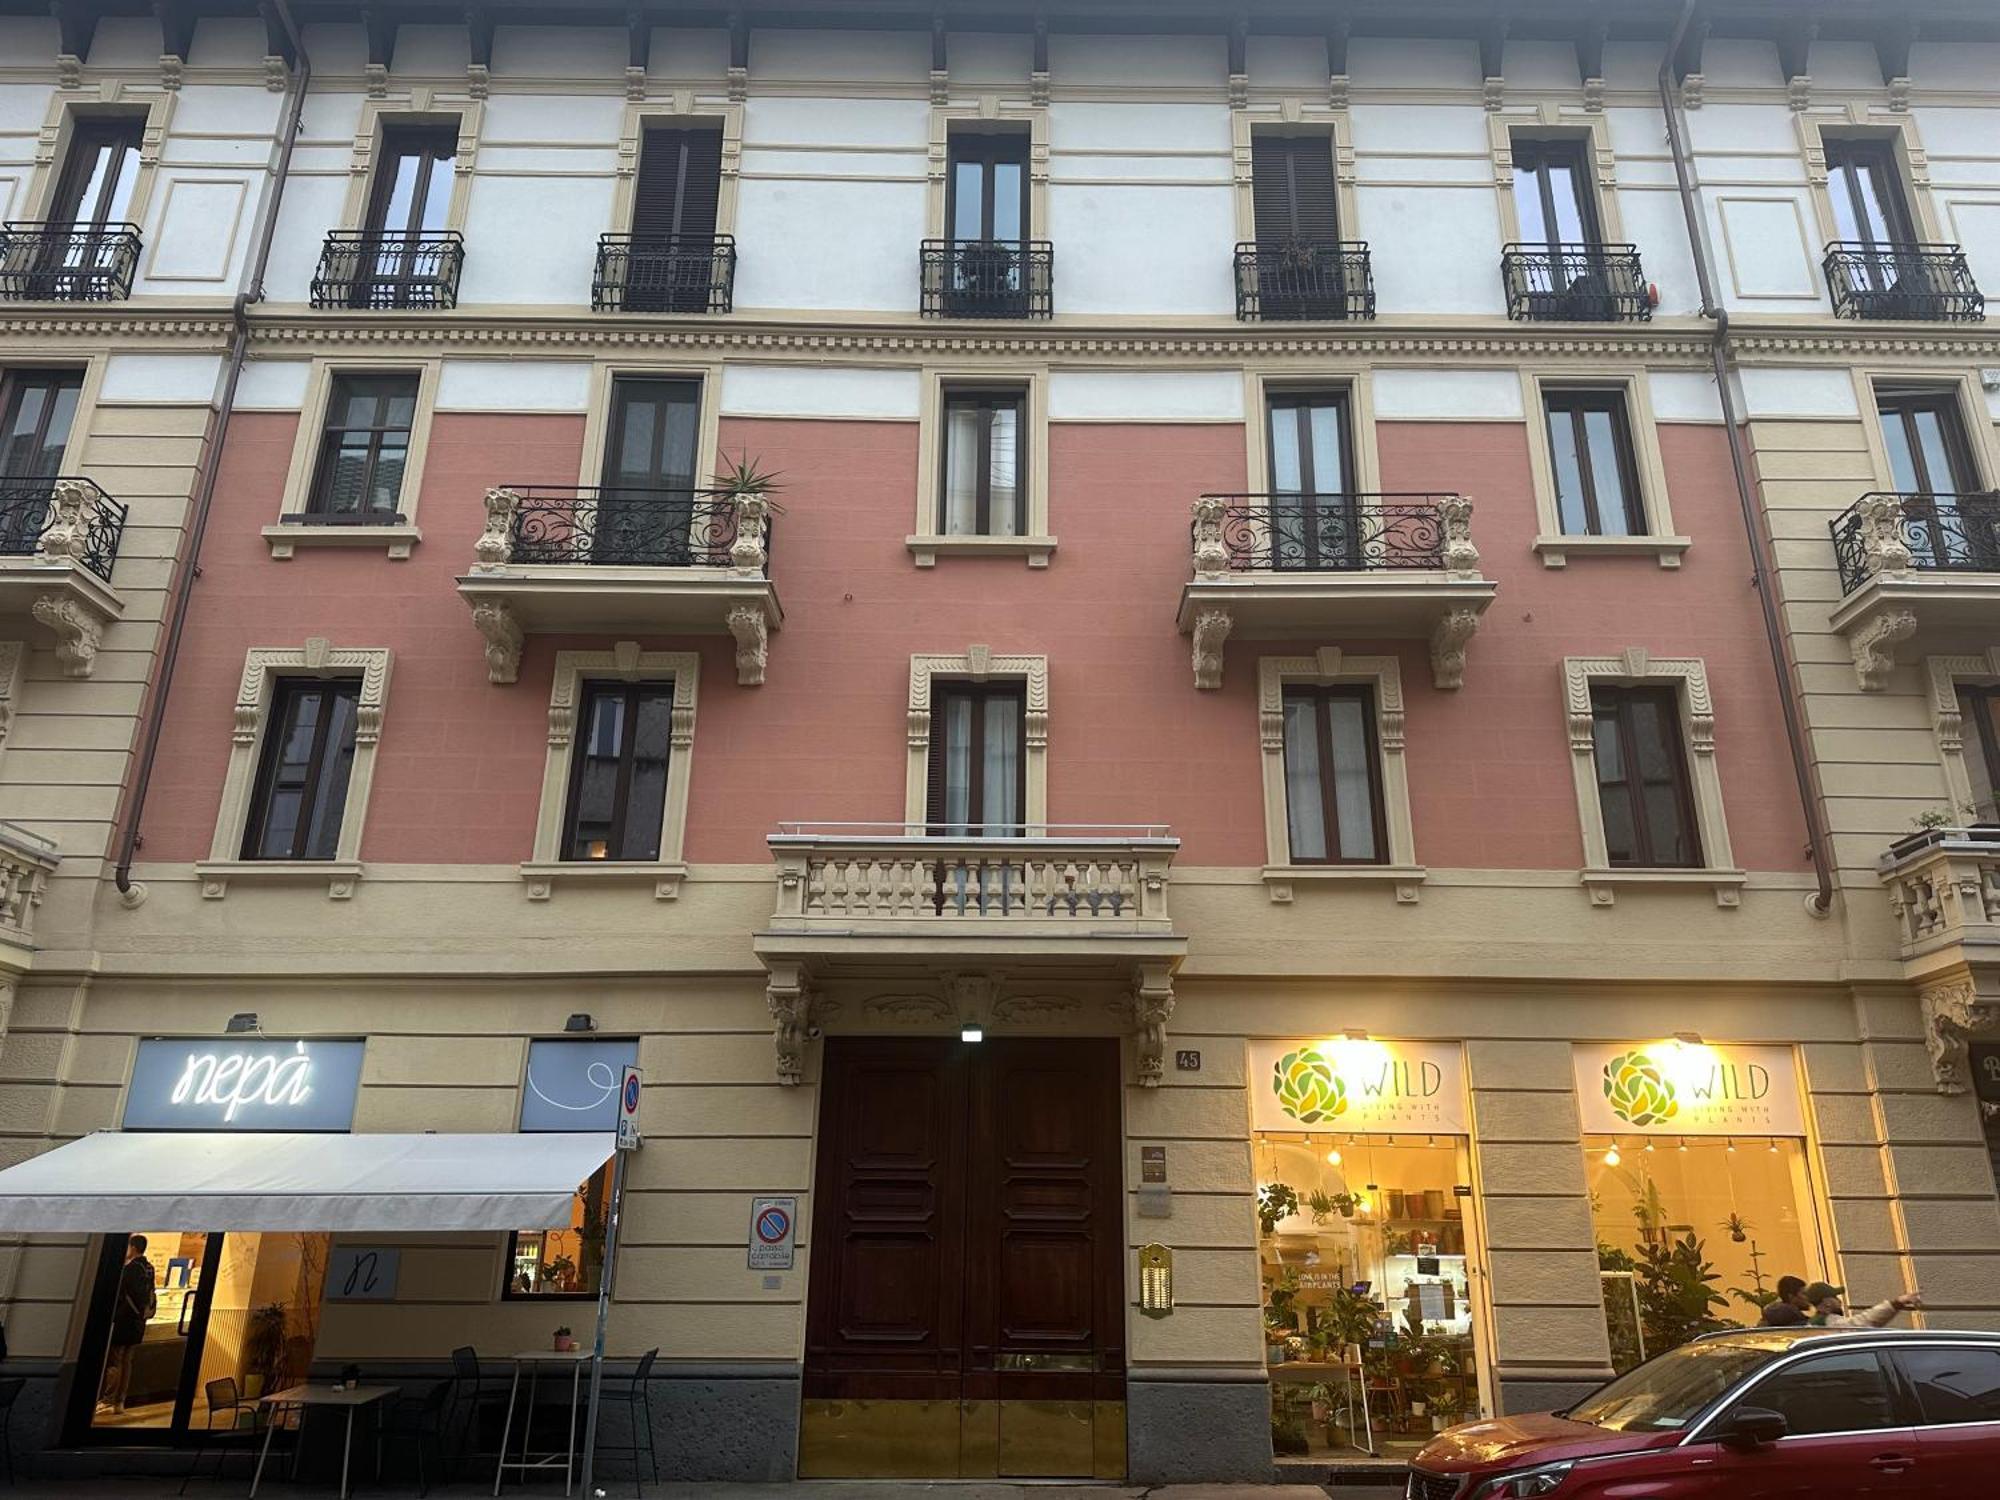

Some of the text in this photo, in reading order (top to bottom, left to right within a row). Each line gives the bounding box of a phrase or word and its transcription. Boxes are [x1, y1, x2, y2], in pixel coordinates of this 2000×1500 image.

[1179, 1052, 1198, 1068] 45
[171, 1040, 311, 1122] nepà
[1362, 1061, 1441, 1097] WILD
[1691, 1064, 1769, 1099] WILD
[1411, 1103, 1439, 1111] WITH
[1741, 1105, 1769, 1113] WITH
[1363, 1112, 1440, 1121] PLANTS
[1694, 1115, 1770, 1124] PLANTS
